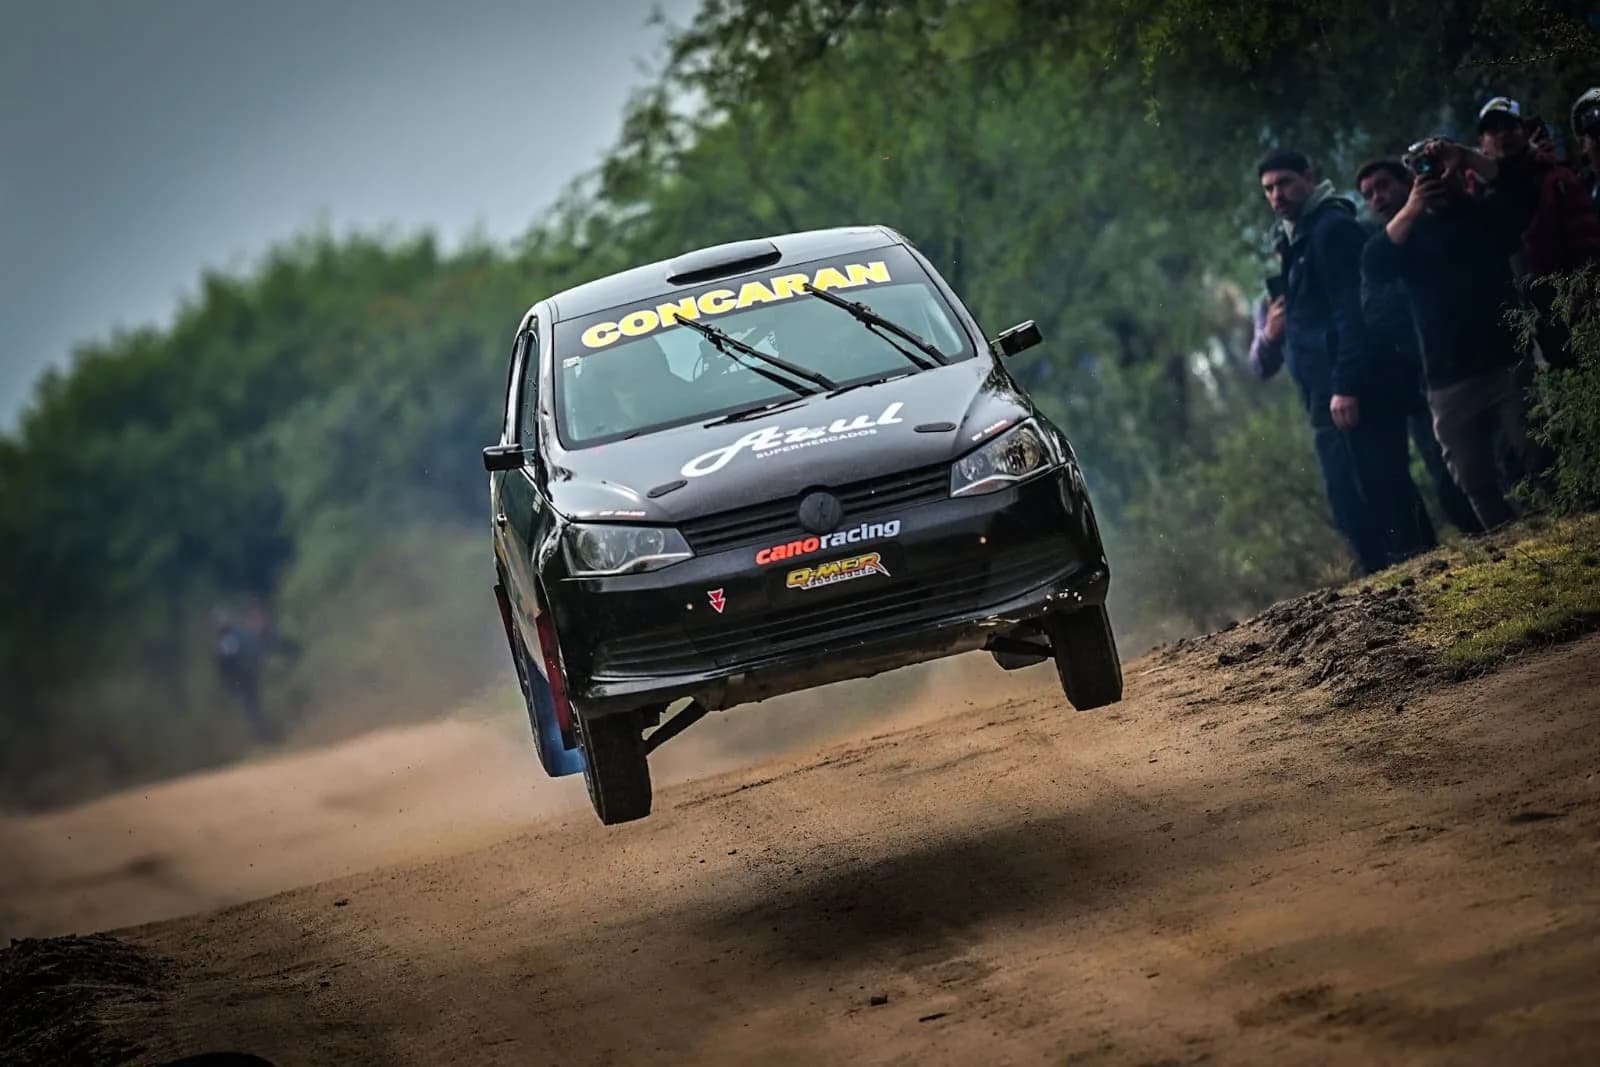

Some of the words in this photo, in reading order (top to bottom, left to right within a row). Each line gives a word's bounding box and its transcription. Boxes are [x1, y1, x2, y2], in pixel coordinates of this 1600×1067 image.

[581, 261, 891, 348] CONCARAN
[681, 402, 904, 477] Azul
[756, 429, 878, 459] SUPERMERCADOS
[756, 519, 900, 565] canoracing
